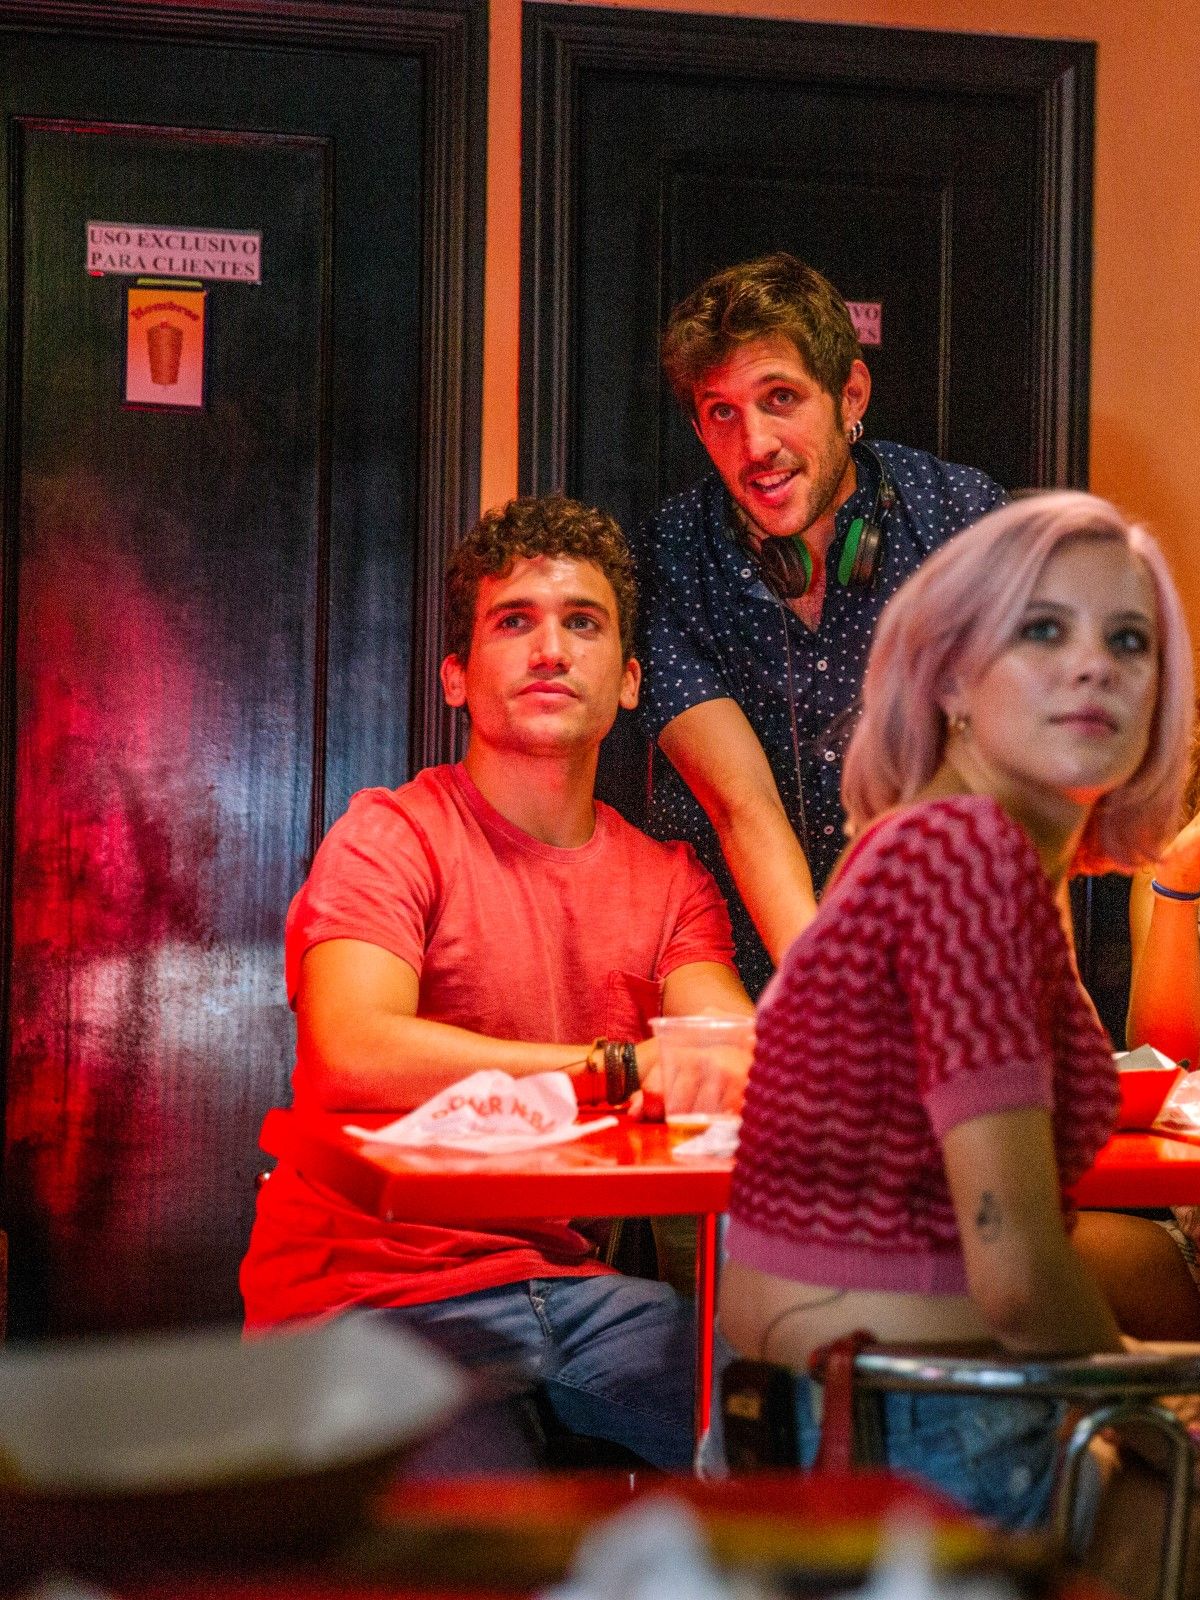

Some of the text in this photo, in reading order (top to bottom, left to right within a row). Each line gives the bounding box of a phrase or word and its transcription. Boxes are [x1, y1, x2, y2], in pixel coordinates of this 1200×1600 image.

[89, 229, 258, 255] USO EXCLUSIVO
[90, 251, 256, 277] PARA CLIENTES
